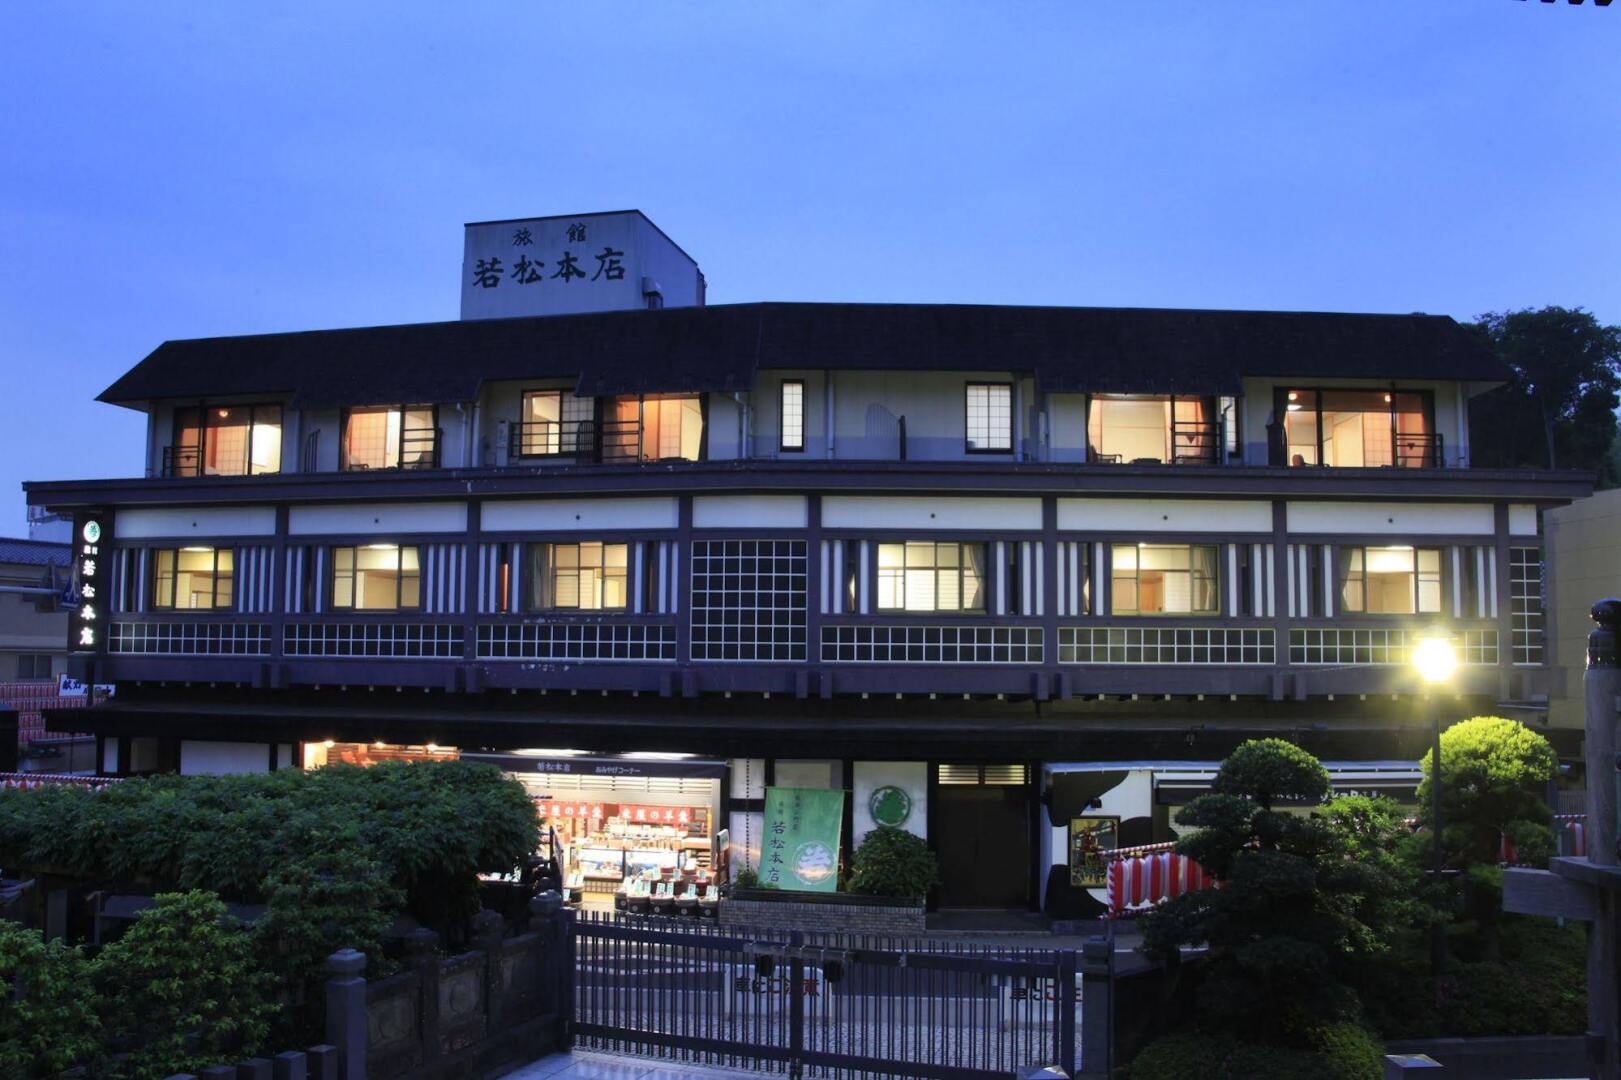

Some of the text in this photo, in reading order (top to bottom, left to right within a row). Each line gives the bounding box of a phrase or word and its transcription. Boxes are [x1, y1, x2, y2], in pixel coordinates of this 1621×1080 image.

[512, 223, 587, 246] 旅館
[472, 247, 626, 288] 若松本店
[80, 560, 96, 645] 若松本店
[768, 821, 786, 882] 若松本店
